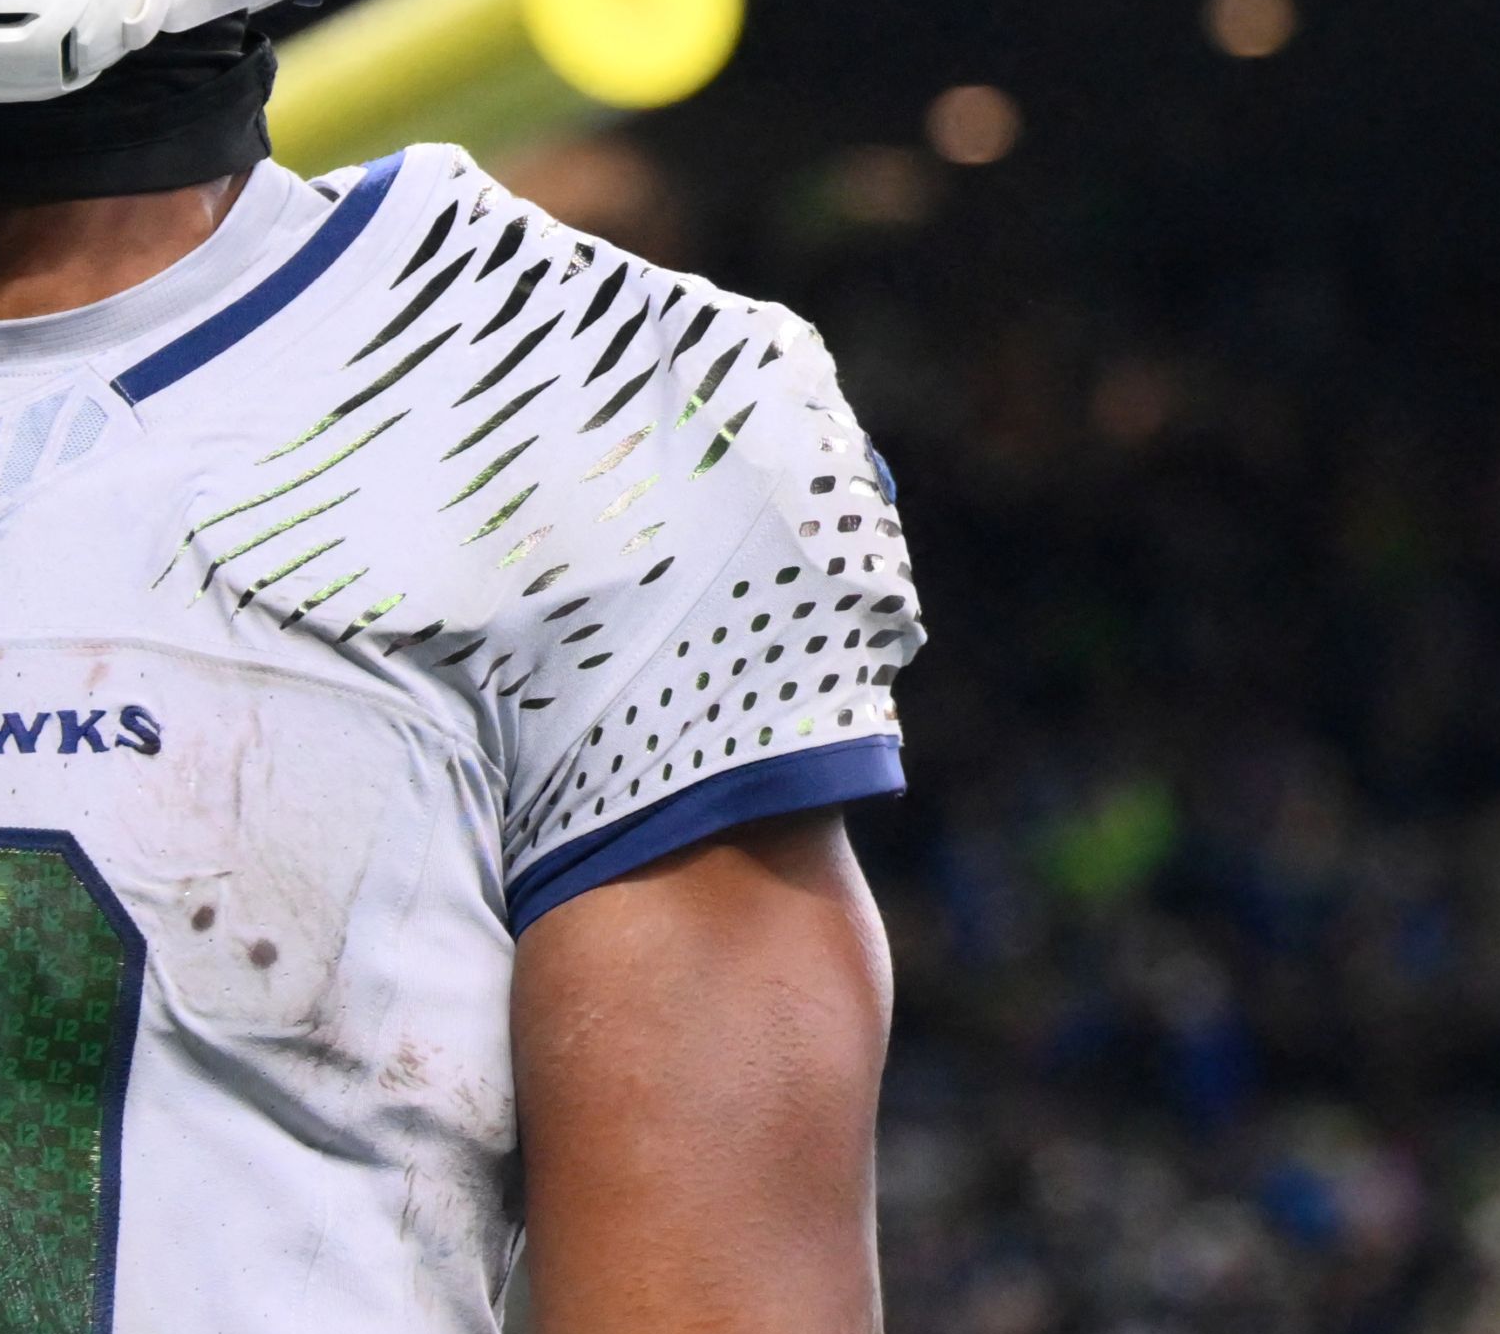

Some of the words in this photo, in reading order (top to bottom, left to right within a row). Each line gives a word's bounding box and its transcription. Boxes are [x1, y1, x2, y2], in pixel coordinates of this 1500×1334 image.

[31, 996, 53, 1016] 12
[87, 1000, 109, 1022] 12
[2, 1014, 24, 1035] 12
[56, 1020, 79, 1041] 12
[24, 1038, 48, 1060] 12
[79, 1042, 103, 1065] 12
[49, 1060, 71, 1083] 12
[72, 1083, 94, 1106] 12
[44, 1104, 67, 1126] 12
[15, 1124, 39, 1146] 12
